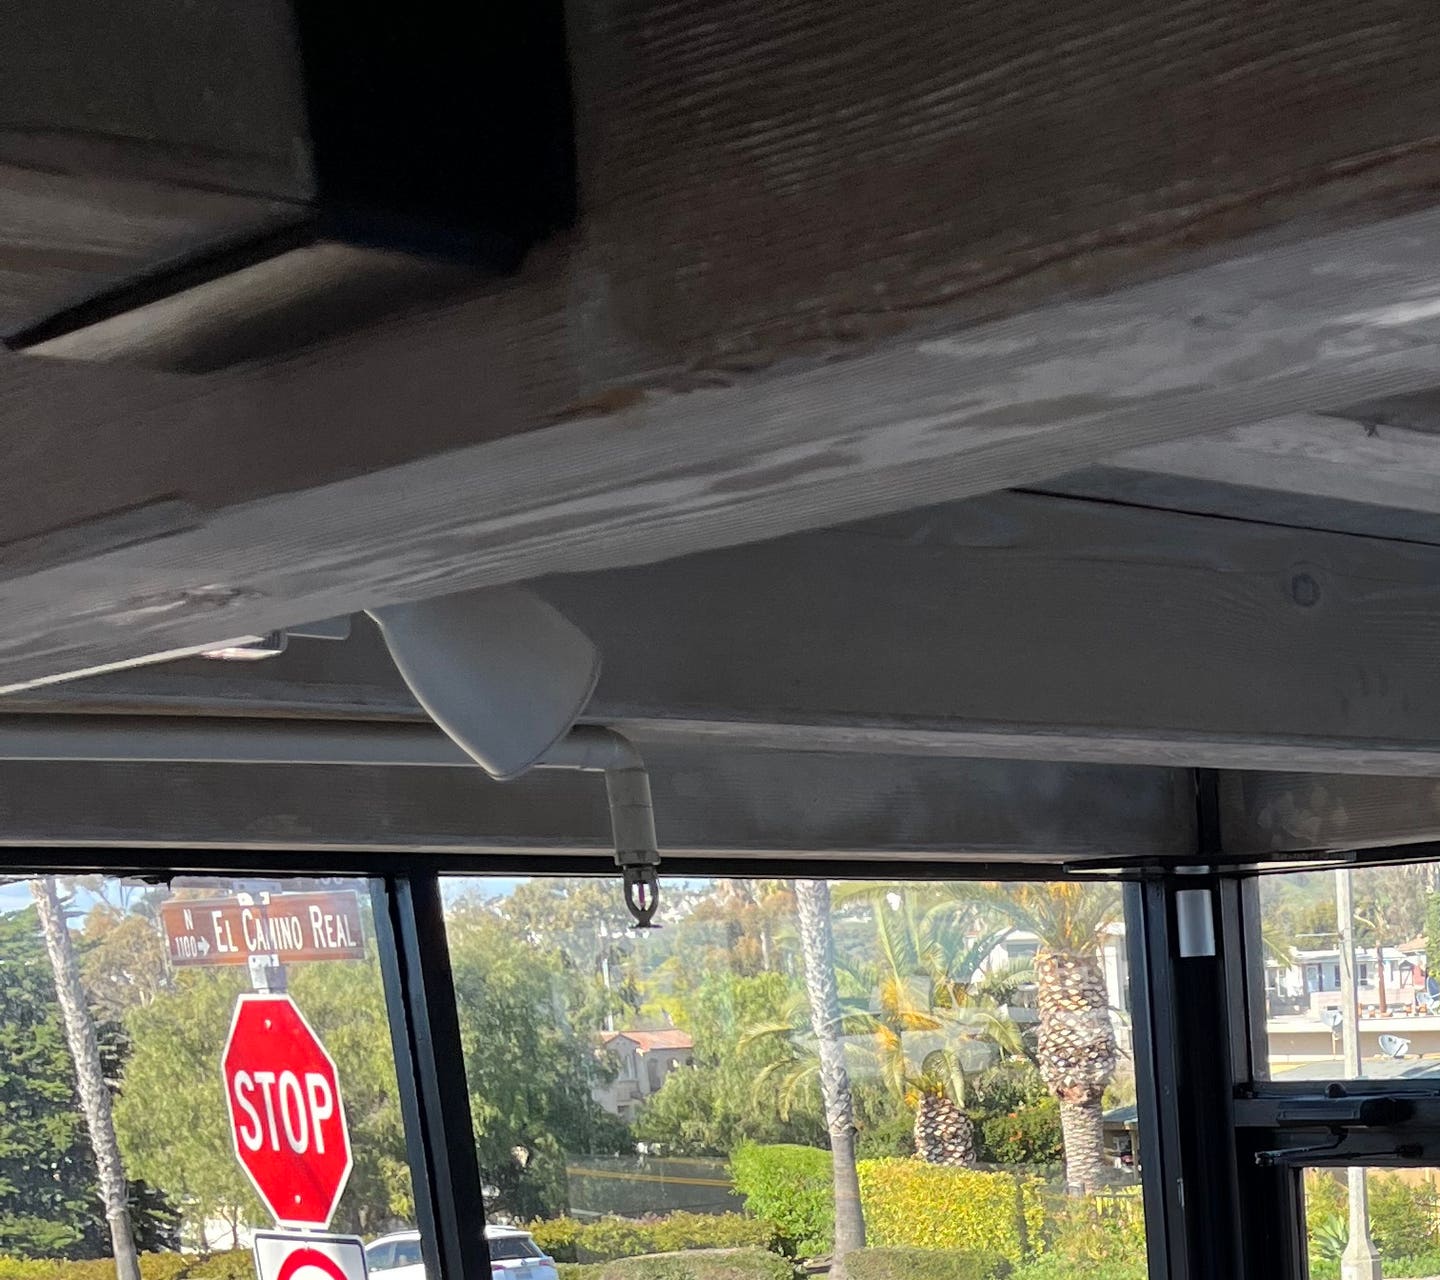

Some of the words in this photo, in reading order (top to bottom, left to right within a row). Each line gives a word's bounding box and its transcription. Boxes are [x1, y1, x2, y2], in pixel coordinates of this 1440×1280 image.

[184, 909, 194, 930] N
[212, 910, 239, 953] EL
[242, 908, 303, 951] CAMINO
[309, 905, 357, 949] REAL
[175, 935, 197, 957] 1100
[234, 1069, 334, 1155] STOP
